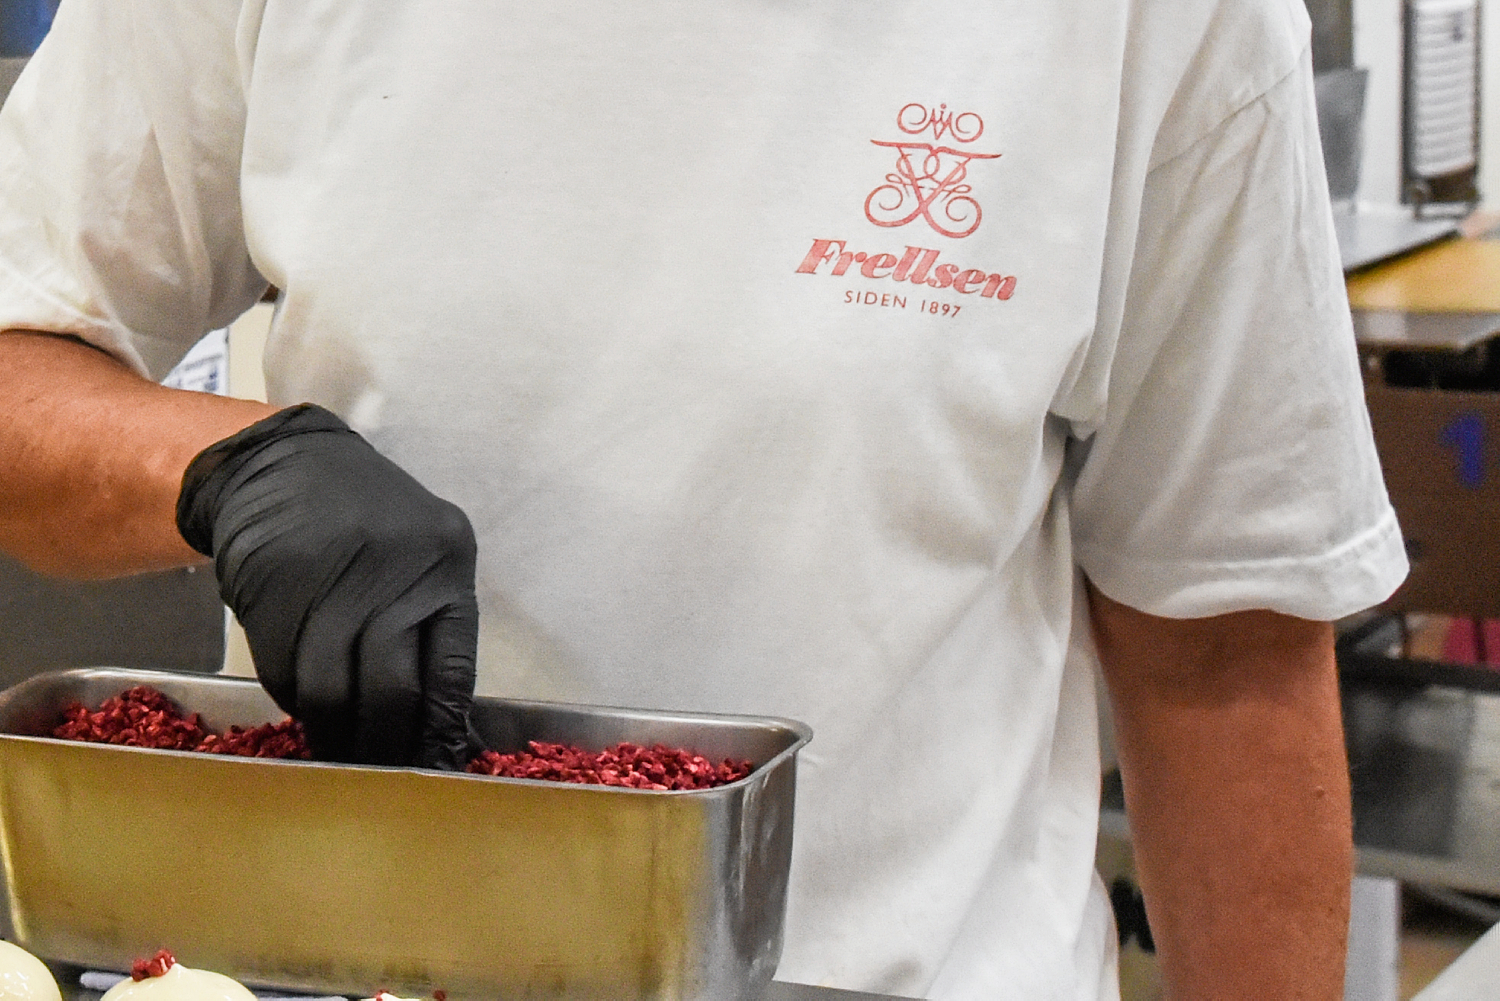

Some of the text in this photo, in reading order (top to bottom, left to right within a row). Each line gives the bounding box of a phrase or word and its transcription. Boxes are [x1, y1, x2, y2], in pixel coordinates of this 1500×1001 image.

[794, 238, 1018, 301] Frellsen
[843, 289, 962, 318] SIDEN 1897
